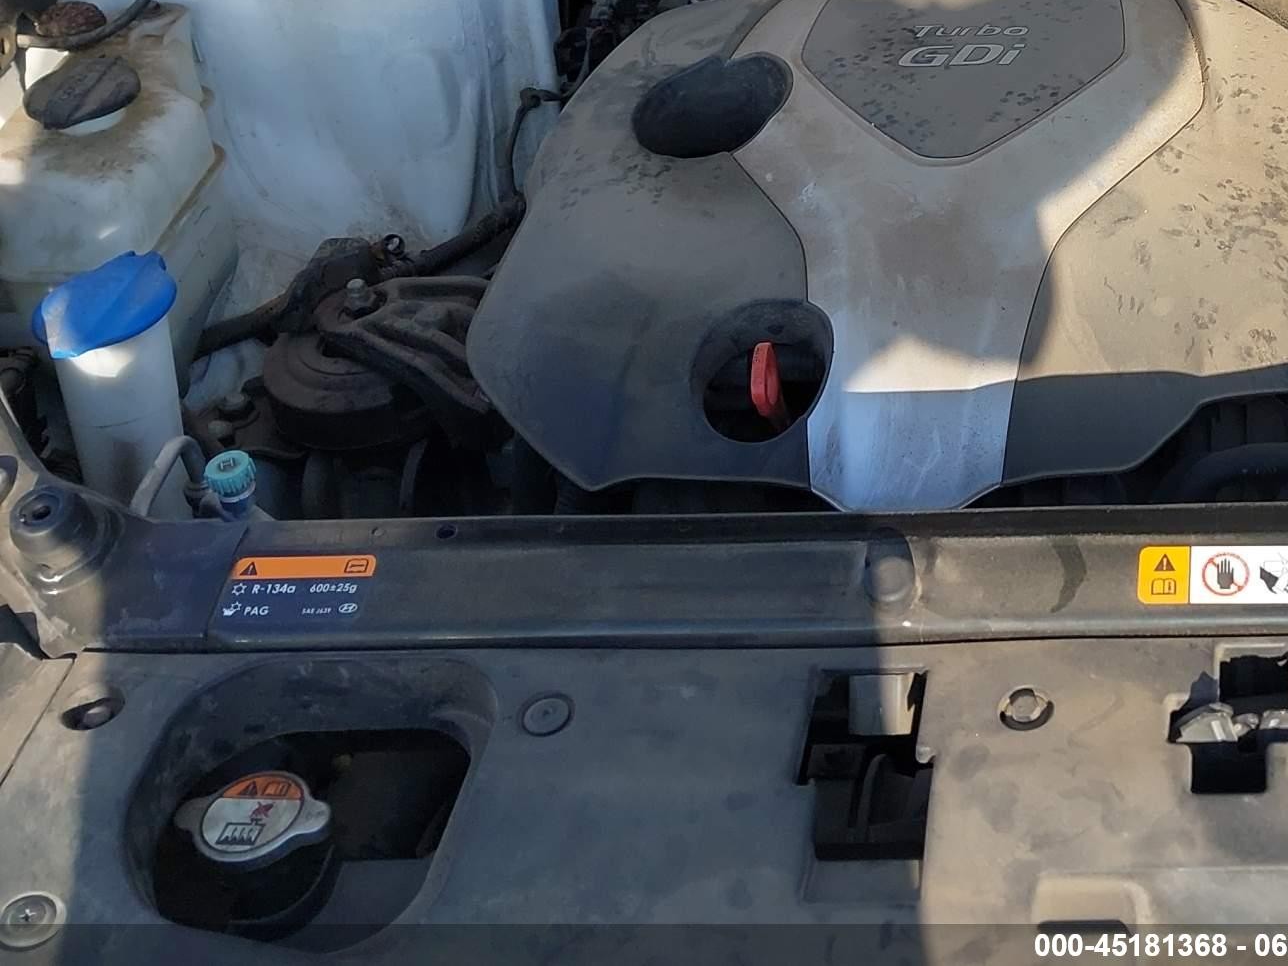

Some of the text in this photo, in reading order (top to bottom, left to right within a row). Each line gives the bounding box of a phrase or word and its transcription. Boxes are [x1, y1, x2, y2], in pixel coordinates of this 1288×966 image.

[912, 23, 1030, 38] Turbo
[897, 42, 1026, 67] GDi
[251, 583, 358, 595] R-134a 600±25g
[244, 605, 269, 616] PAG
